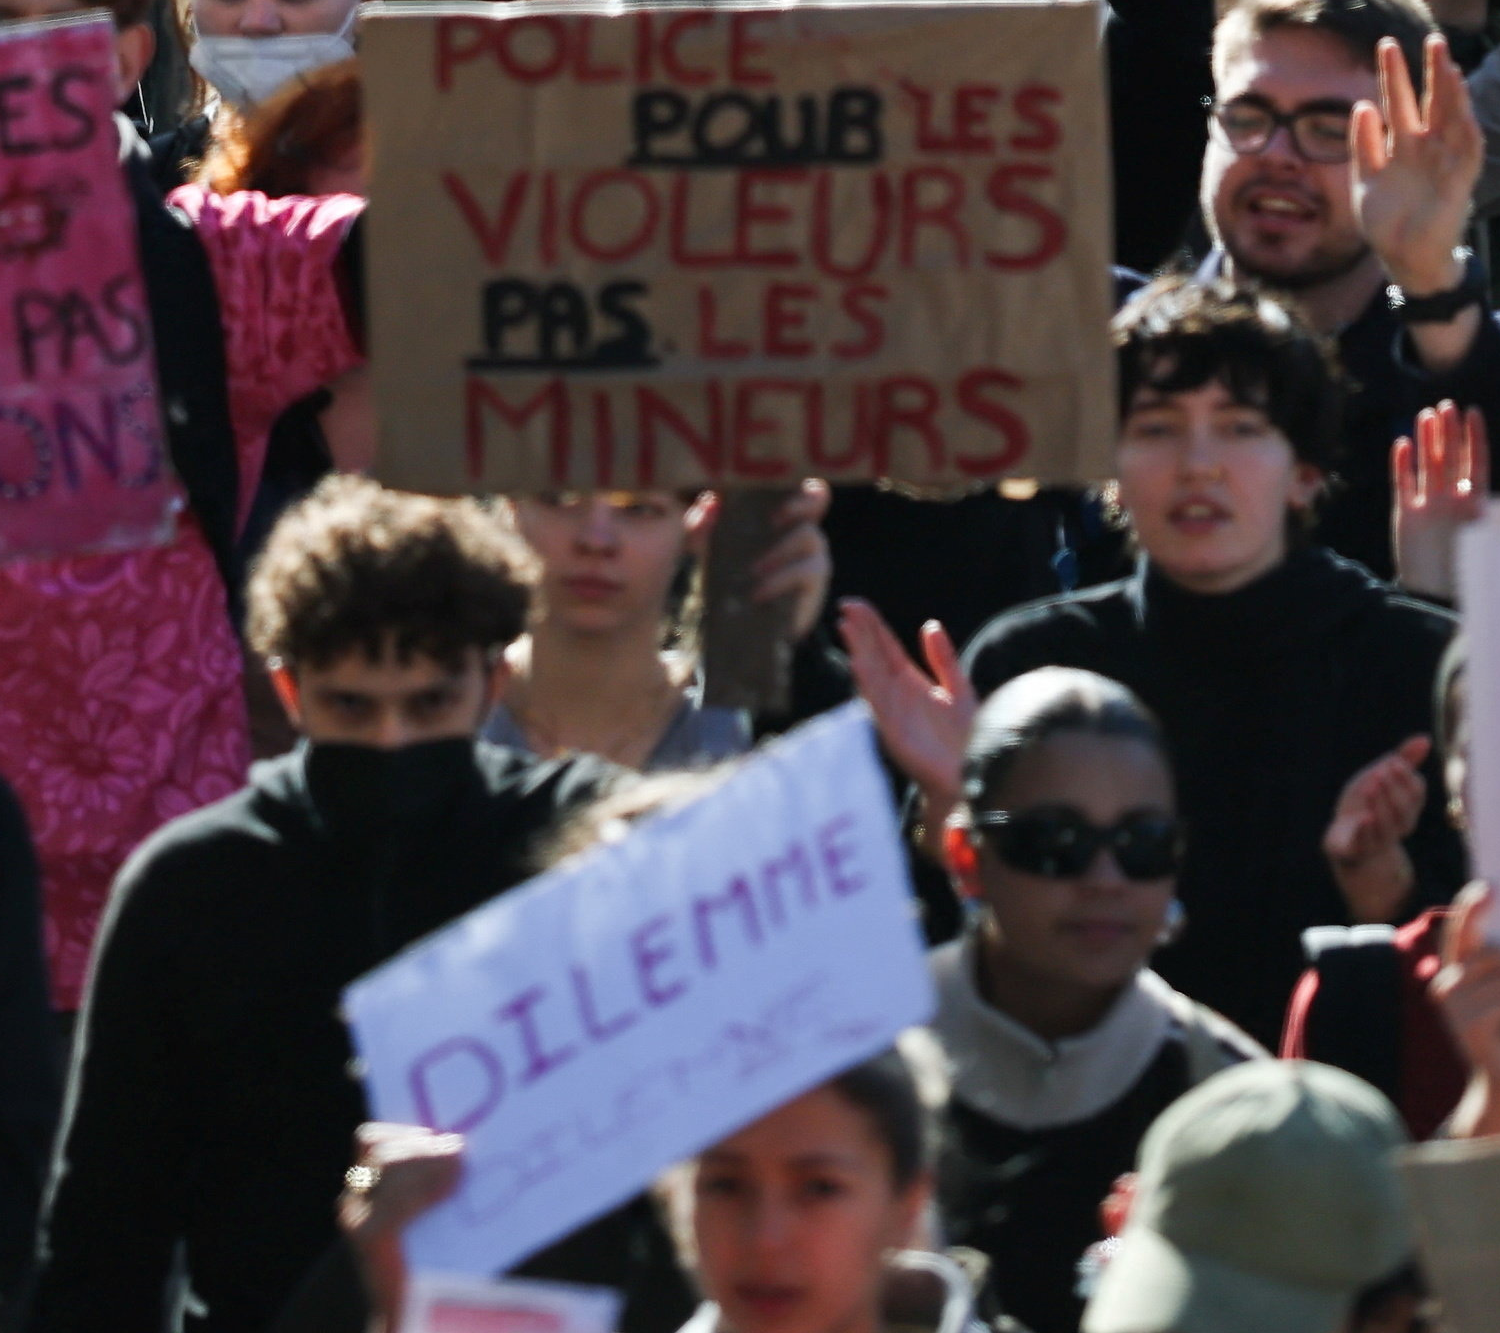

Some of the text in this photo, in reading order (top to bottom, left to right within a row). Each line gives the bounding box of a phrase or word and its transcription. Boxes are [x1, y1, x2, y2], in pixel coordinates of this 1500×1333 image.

[432, 9, 781, 94] POLICE
[903, 80, 1067, 155] LES
[443, 164, 1071, 281] VIOLEURS
[14, 274, 150, 379] PAS
[478, 276, 891, 361] PAS LES
[464, 368, 1033, 489] MINEURS
[408, 811, 873, 1135] DILEMME
